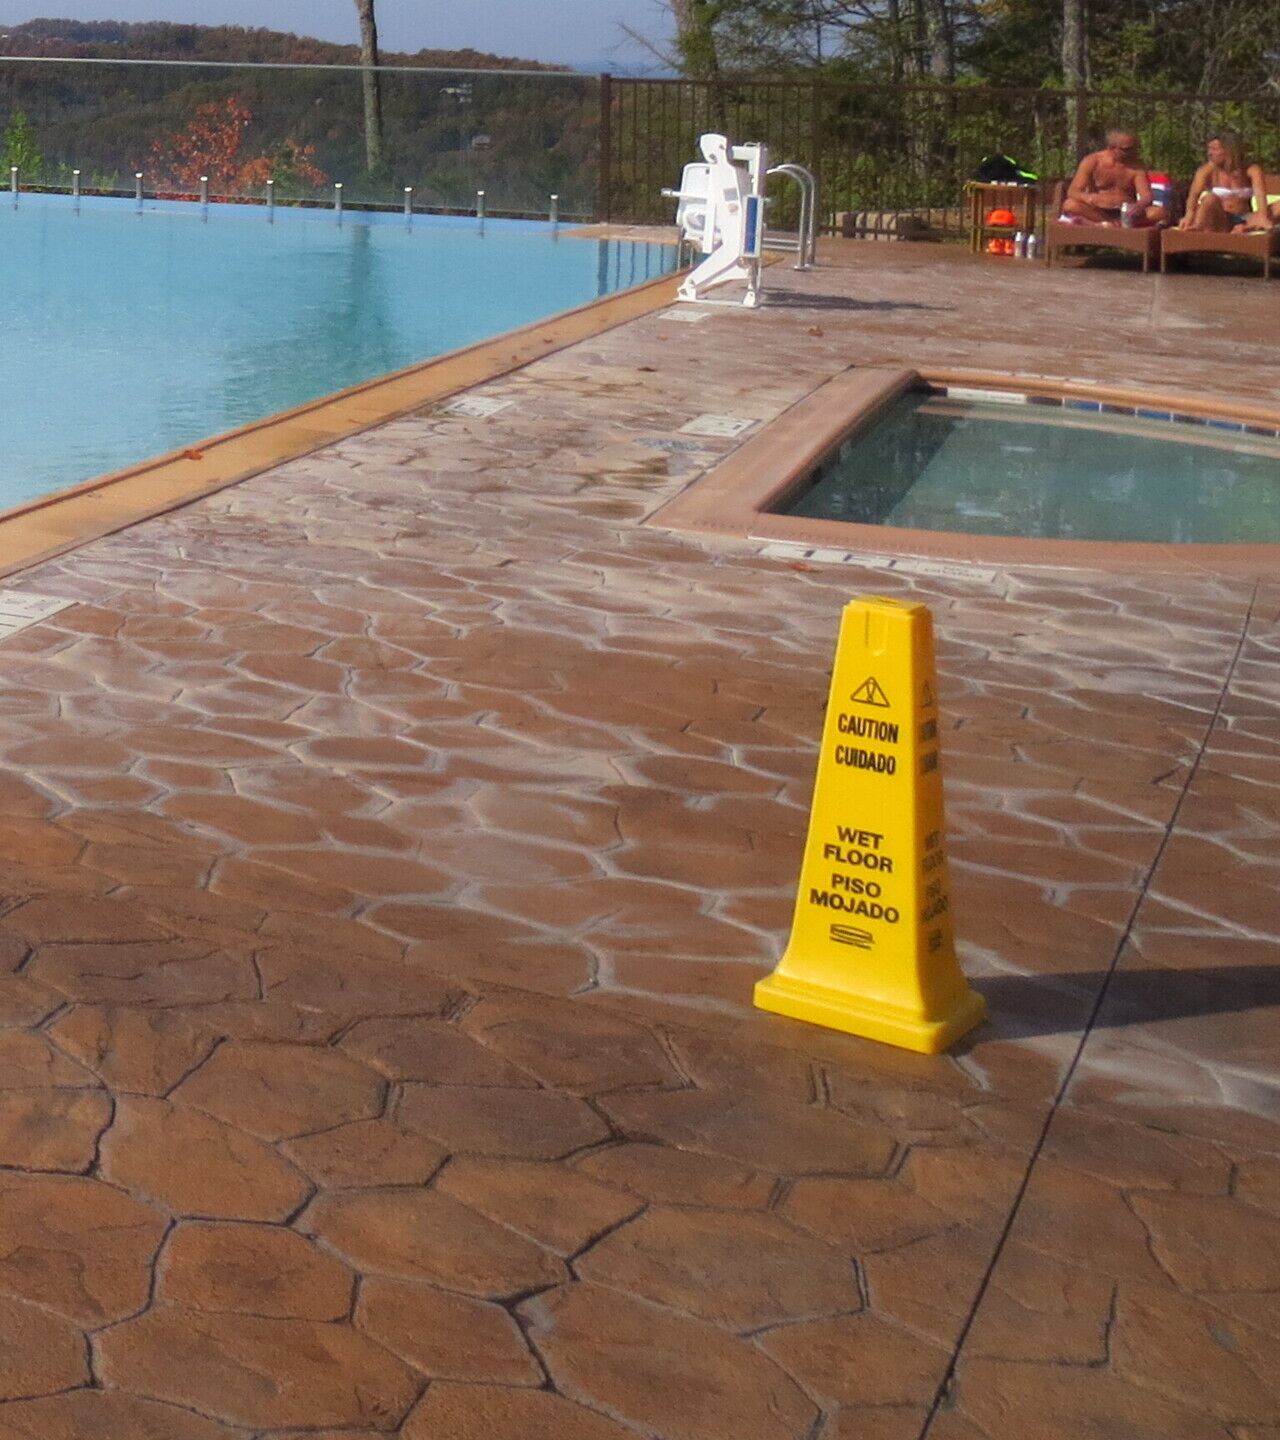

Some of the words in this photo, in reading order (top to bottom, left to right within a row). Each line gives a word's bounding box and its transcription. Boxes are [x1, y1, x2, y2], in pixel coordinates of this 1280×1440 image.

[837, 712, 899, 744] CAUTION
[835, 744, 896, 776] CUIDADO
[836, 825, 884, 850] WET
[823, 843, 893, 874] FLOOR
[831, 873, 882, 899] PISO
[809, 888, 900, 924] MOJADO
